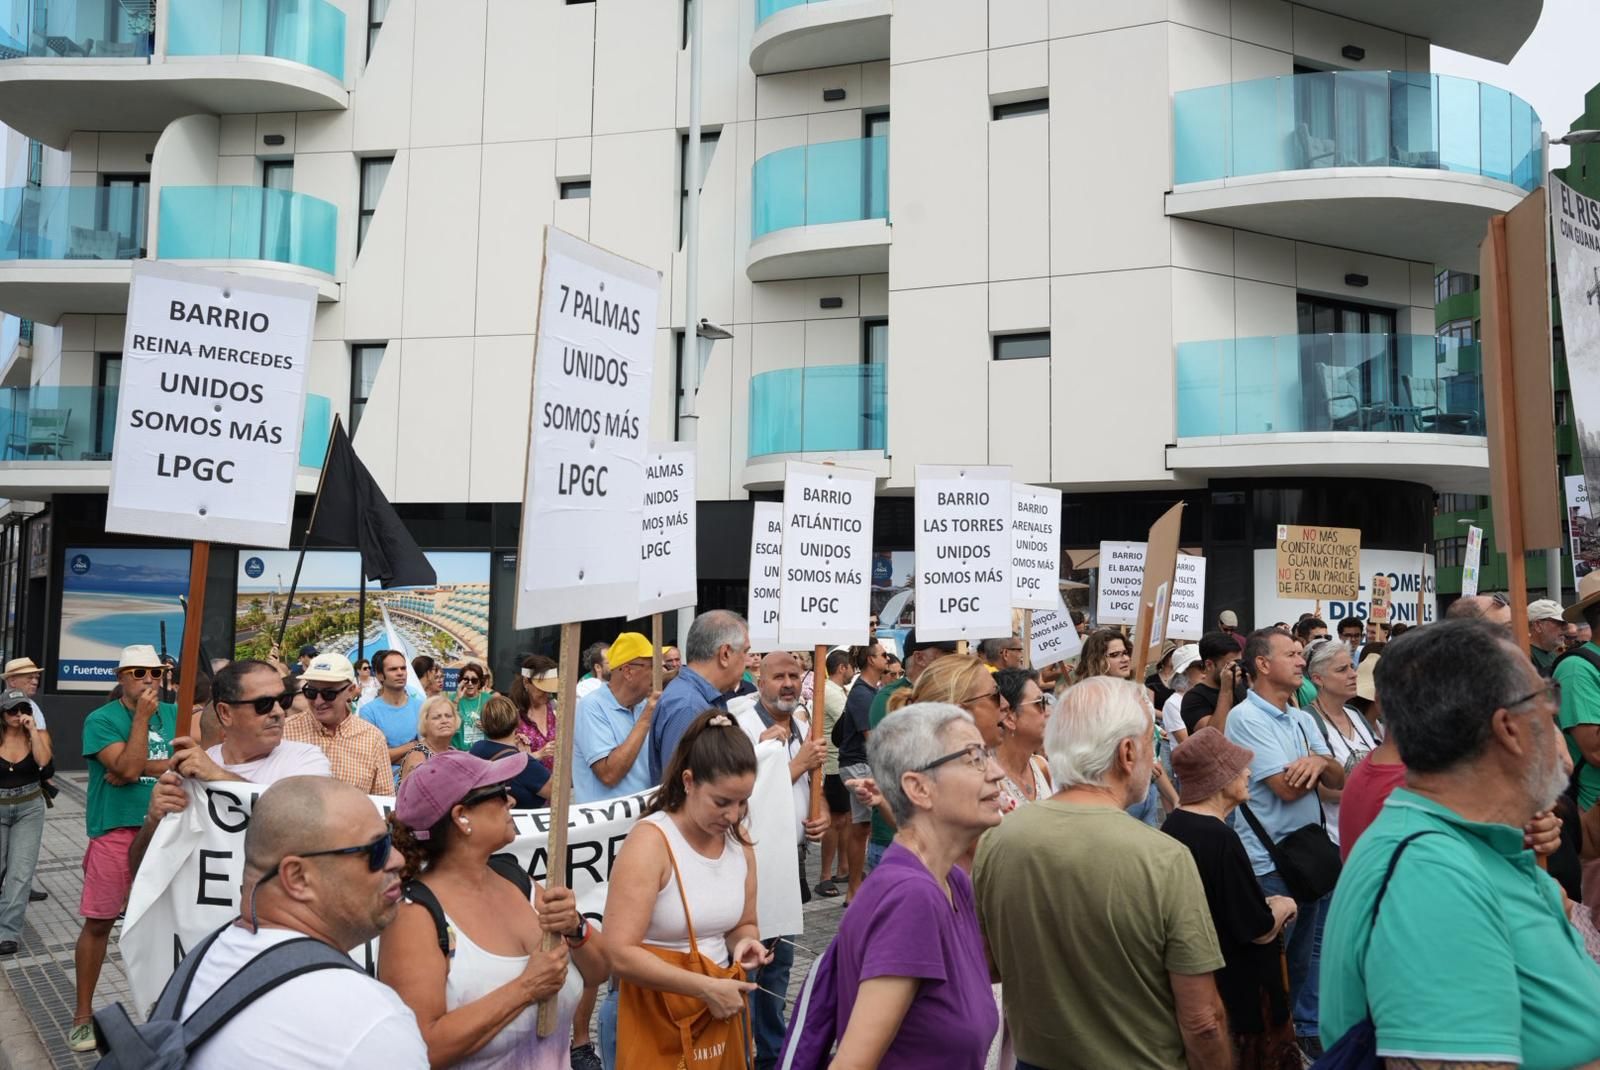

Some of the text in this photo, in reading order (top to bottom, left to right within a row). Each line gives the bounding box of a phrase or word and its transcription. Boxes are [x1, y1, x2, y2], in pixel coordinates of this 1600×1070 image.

[1561, 184, 1575, 219] EL
[170, 301, 269, 332] BARRIO
[560, 285, 640, 335] 7 PALMAS
[133, 335, 292, 370] REINA MERCEDES
[563, 347, 628, 386] UNIDOS
[160, 372, 263, 403] UNIDOS
[130, 409, 282, 444] SOMOS MÁS
[543, 402, 639, 439] SOMOS MÁS
[157, 454, 235, 483] LPGC
[646, 464, 684, 479] ALMAS
[558, 463, 608, 496] LPGC
[803, 488, 851, 505] BARRIO
[938, 492, 989, 505] BARRIO
[1018, 502, 1048, 515] BARRIO
[666, 510, 688, 526] MÁS
[791, 513, 861, 532] ATLÁNTICO
[924, 519, 1004, 532] LAS TORRES
[1012, 520, 1052, 534] ARENALES
[1303, 528, 1316, 541] NO
[641, 541, 671, 560] LPGC
[800, 543, 851, 558] UNIDOS
[937, 545, 990, 559] UNIDOS
[1016, 540, 1048, 552] UNIDOS
[1281, 540, 1357, 557] CONSTRUCCIONES
[1112, 552, 1143, 560] BARRIO
[1288, 554, 1354, 570] GUANARTEME
[1037, 559, 1054, 570] MÁS
[788, 569, 831, 583] SOMOS
[835, 569, 861, 584] MÁS
[924, 568, 1003, 584] SOMOS MÁS
[1017, 576, 1040, 589] LPGC
[1110, 577, 1142, 585] UNIDOS
[1279, 568, 1355, 583] NO ES UN PARQUE
[1279, 582, 1355, 597] DE ATRACCIONES
[801, 597, 839, 613] LPGC
[940, 597, 980, 613] LPGC
[1110, 602, 1134, 610] LPGC
[764, 610, 779, 623] LP
[1171, 614, 1188, 623] LPGC
[1038, 637, 1061, 651] LPGC
[73, 665, 115, 675] Fuerteve
